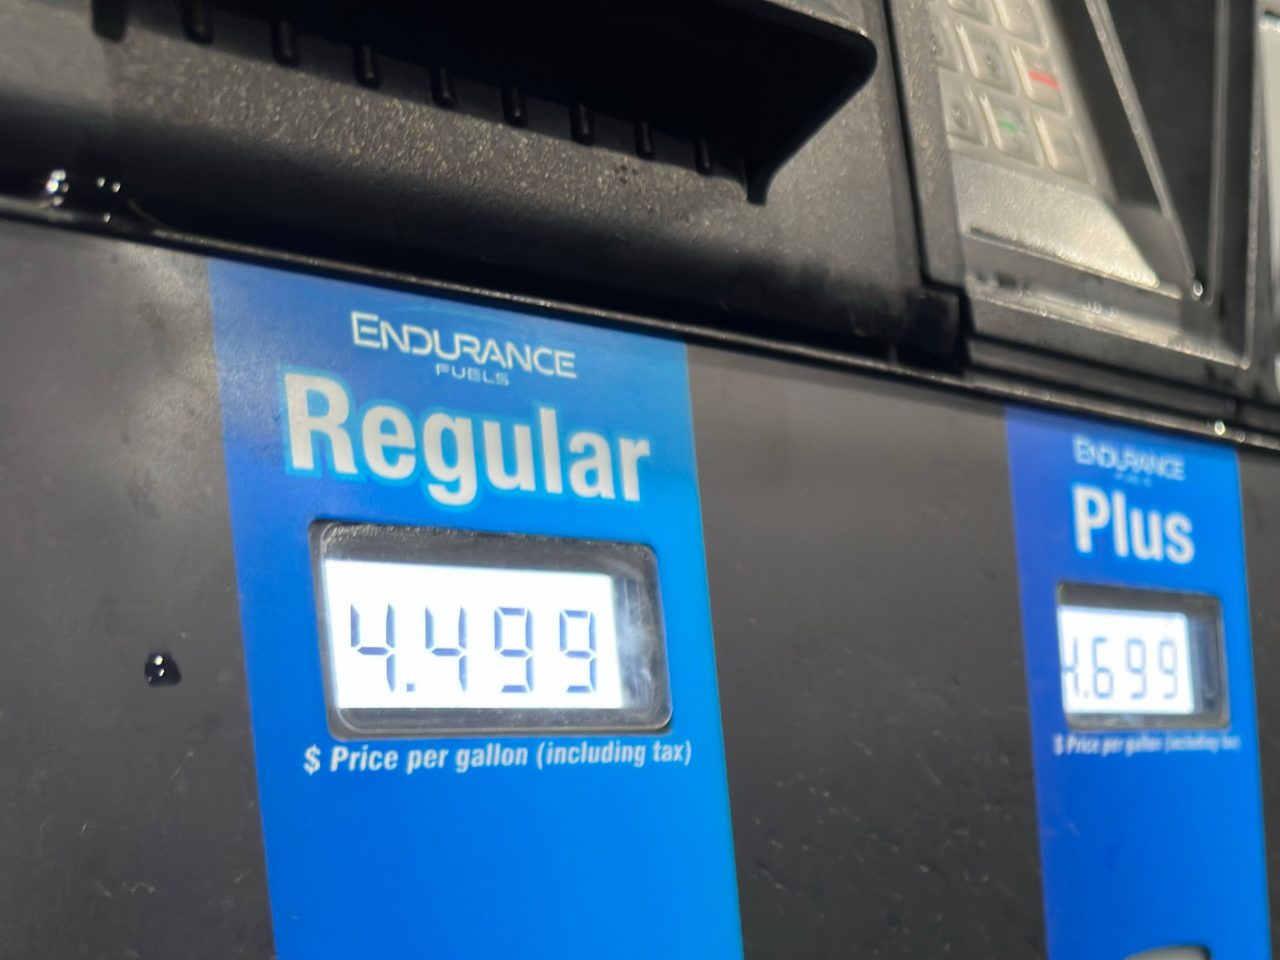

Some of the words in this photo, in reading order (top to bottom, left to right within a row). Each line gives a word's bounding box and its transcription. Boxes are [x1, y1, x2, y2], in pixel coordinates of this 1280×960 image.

[349, 311, 578, 380] ENDURANCE
[435, 364, 510, 387] FUELS
[284, 372, 651, 507] Regular
[1072, 484, 1196, 565] Plus
[350, 602, 598, 694] 4.499
[303, 744, 321, 775] $
[330, 744, 398, 773] Price
[406, 749, 448, 774] per
[454, 741, 528, 771] gallon
[536, 741, 646, 769] (including
[652, 740, 693, 766] tax)
